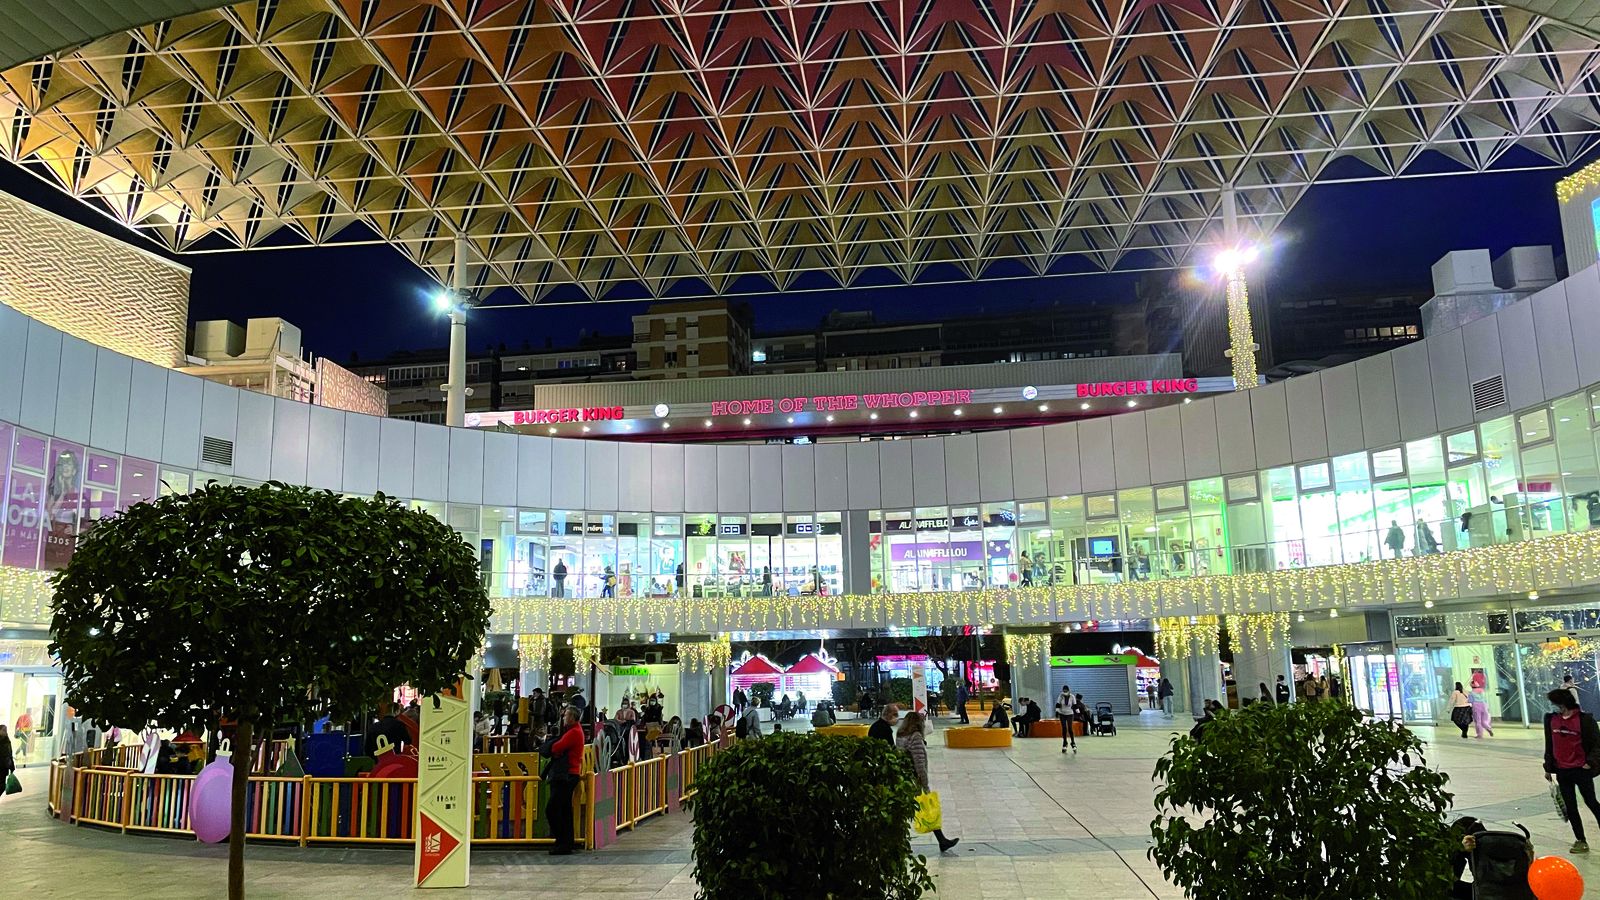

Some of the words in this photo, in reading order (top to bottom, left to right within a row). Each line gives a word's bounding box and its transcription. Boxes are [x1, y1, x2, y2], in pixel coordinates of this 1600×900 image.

[1076, 380, 1148, 397] BURGER
[1151, 378, 1198, 393] KING
[711, 399, 774, 416] HOME
[779, 398, 807, 413] OF
[813, 395, 857, 411] THE
[863, 390, 972, 409] WHOPPER
[514, 408, 579, 424] BURGER
[582, 406, 624, 421] KING
[11, 479, 36, 503] LA
